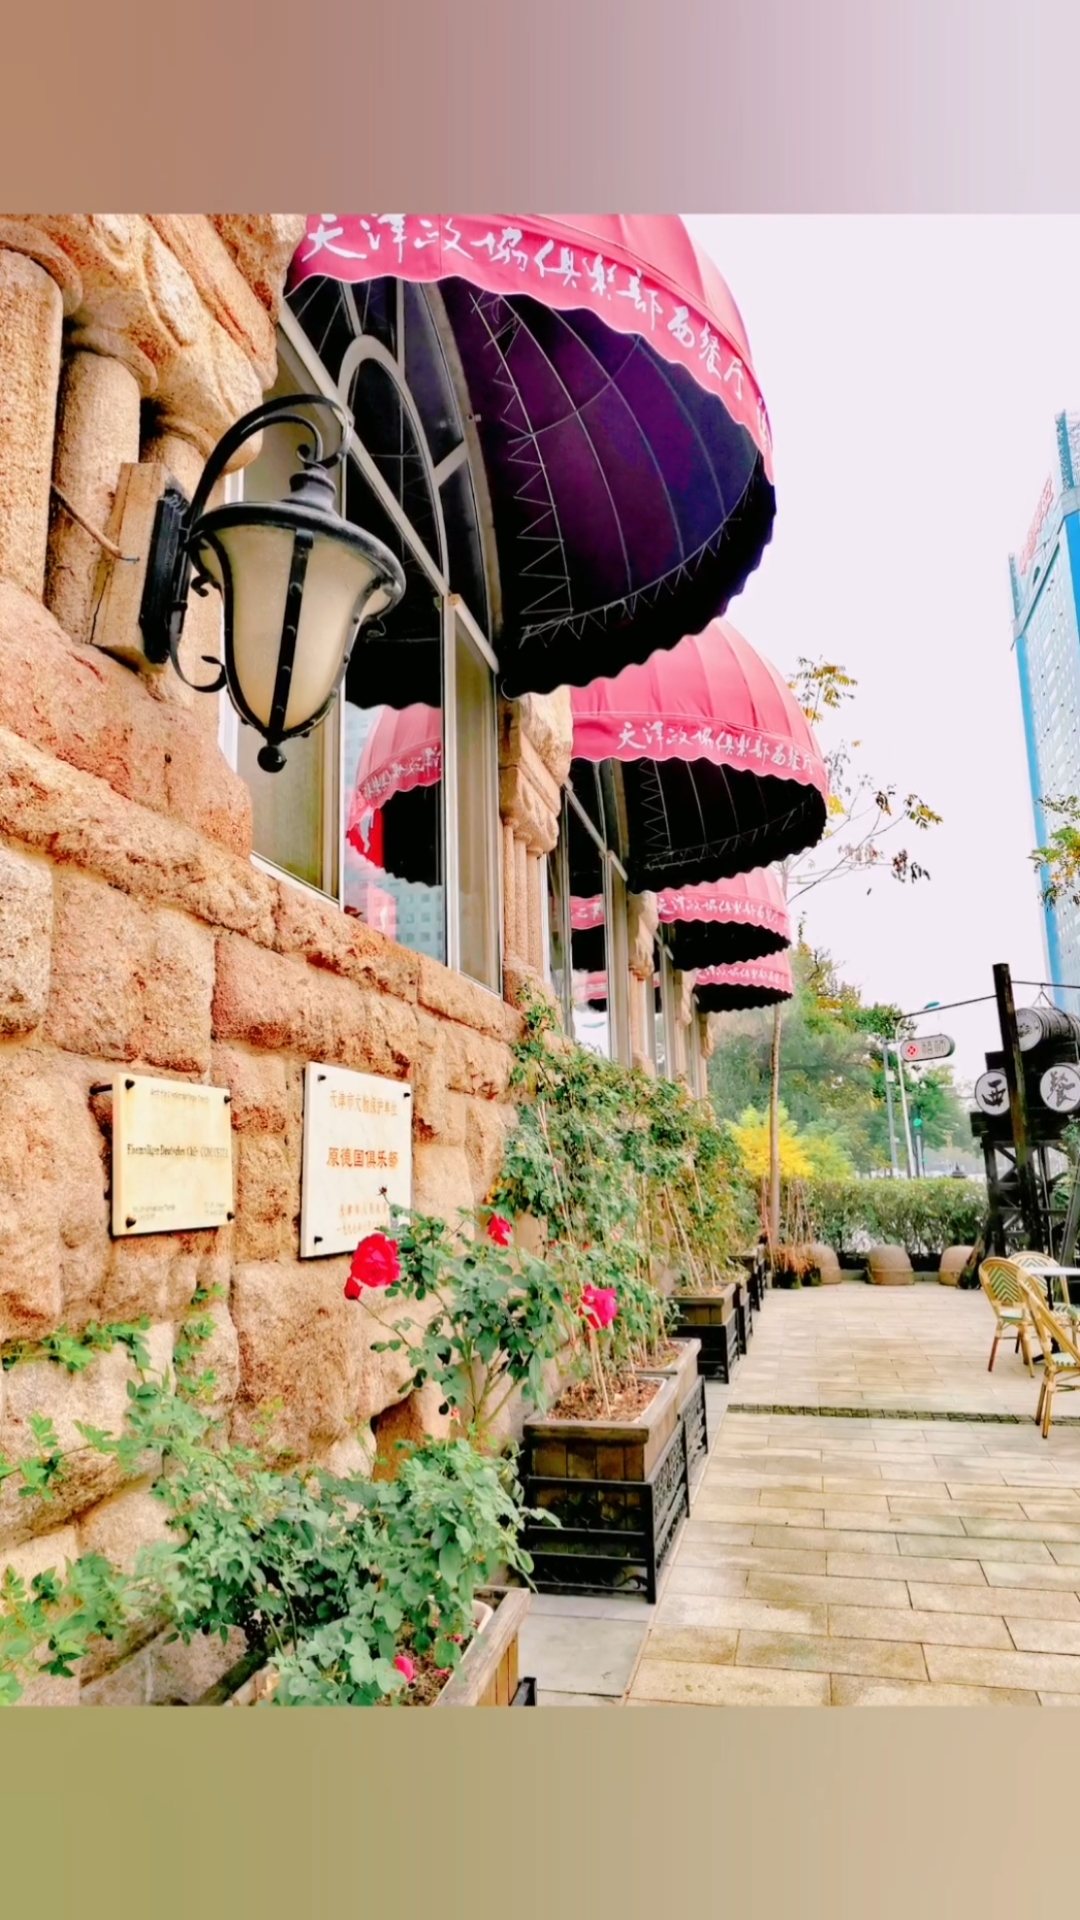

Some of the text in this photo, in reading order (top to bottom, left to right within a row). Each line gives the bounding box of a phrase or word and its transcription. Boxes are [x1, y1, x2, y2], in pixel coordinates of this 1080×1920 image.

[326, 1147, 399, 1170] 原德国俱乐部
